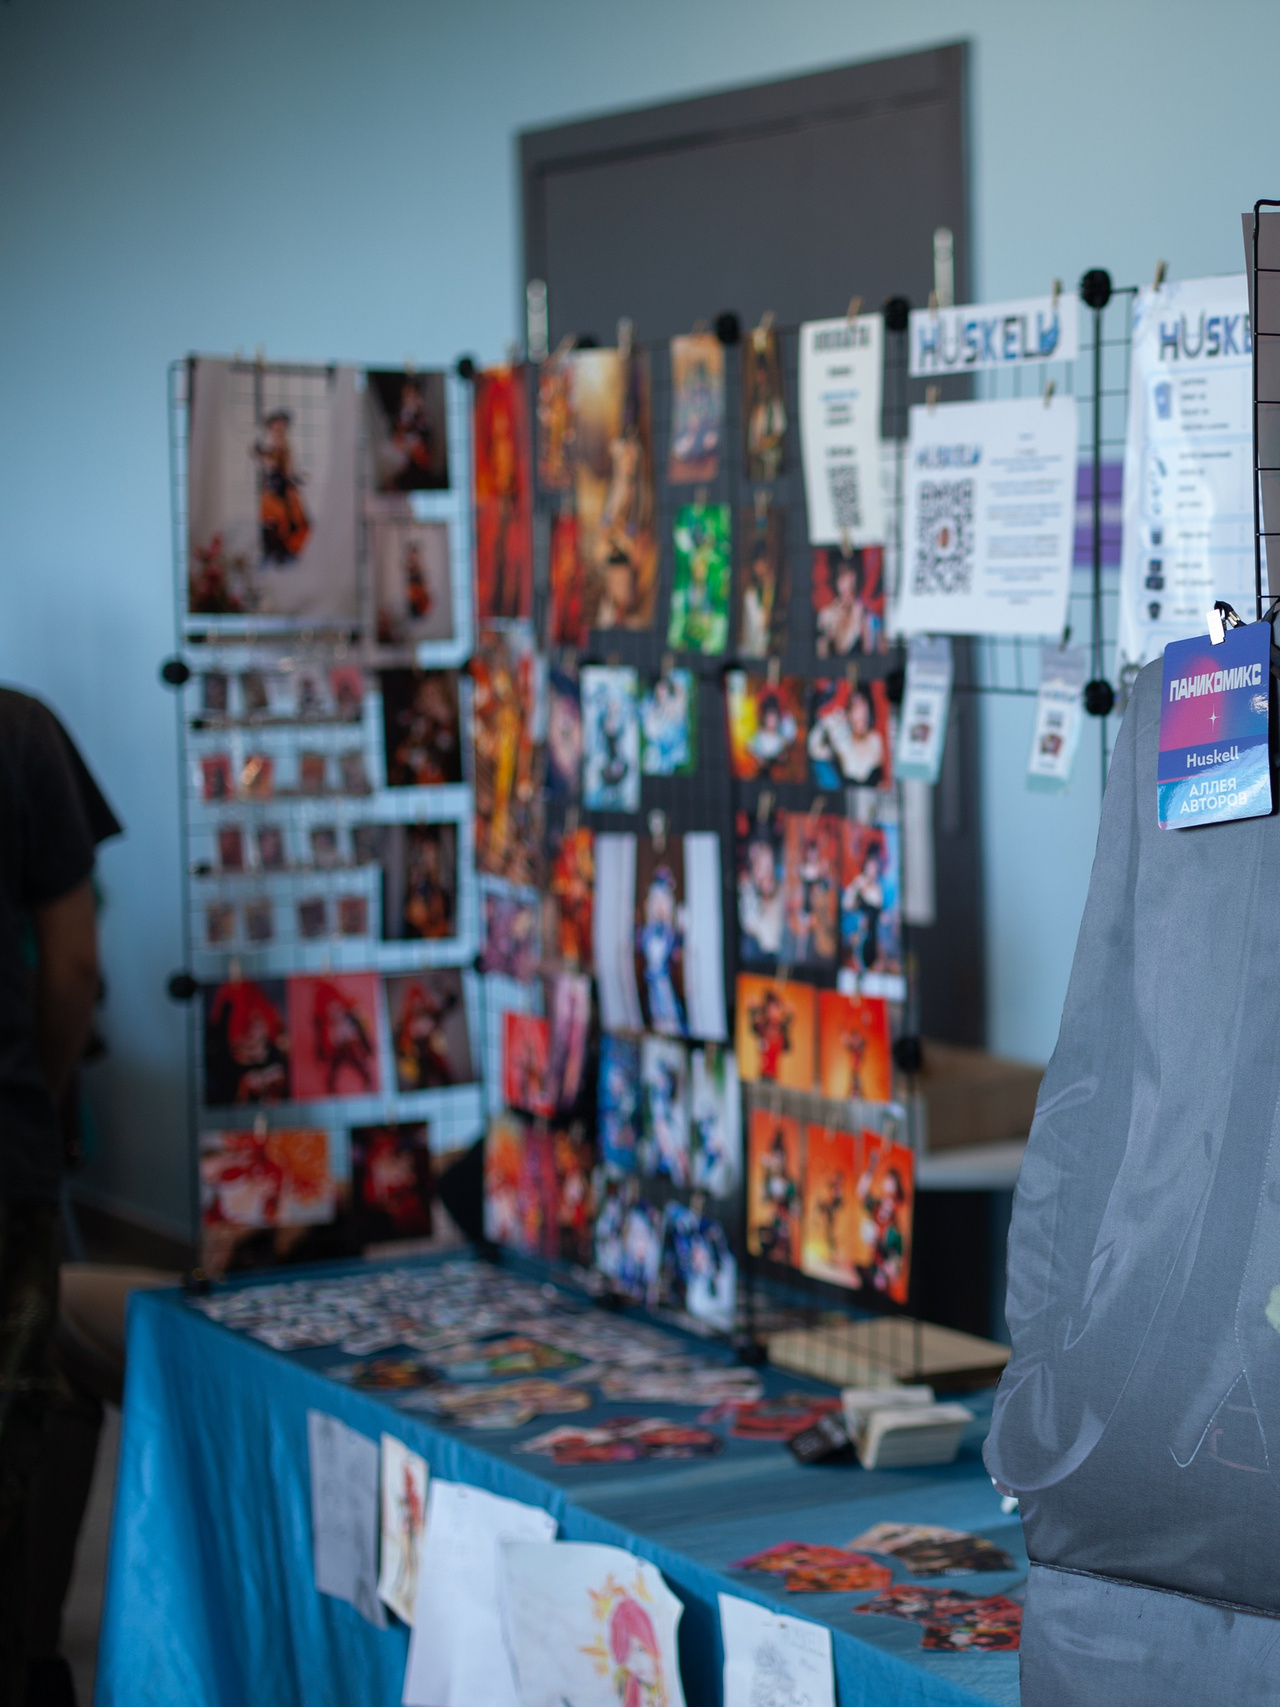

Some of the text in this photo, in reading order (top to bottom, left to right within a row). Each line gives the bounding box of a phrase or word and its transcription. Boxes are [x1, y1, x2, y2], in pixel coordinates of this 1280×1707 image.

[1169, 662, 1262, 702] ПАНИКОМИКС
[1186, 745, 1240, 769] Huskell
[1189, 777, 1237, 798] АЛЛЕЯ
[1180, 790, 1248, 814] АВТОРОВ
